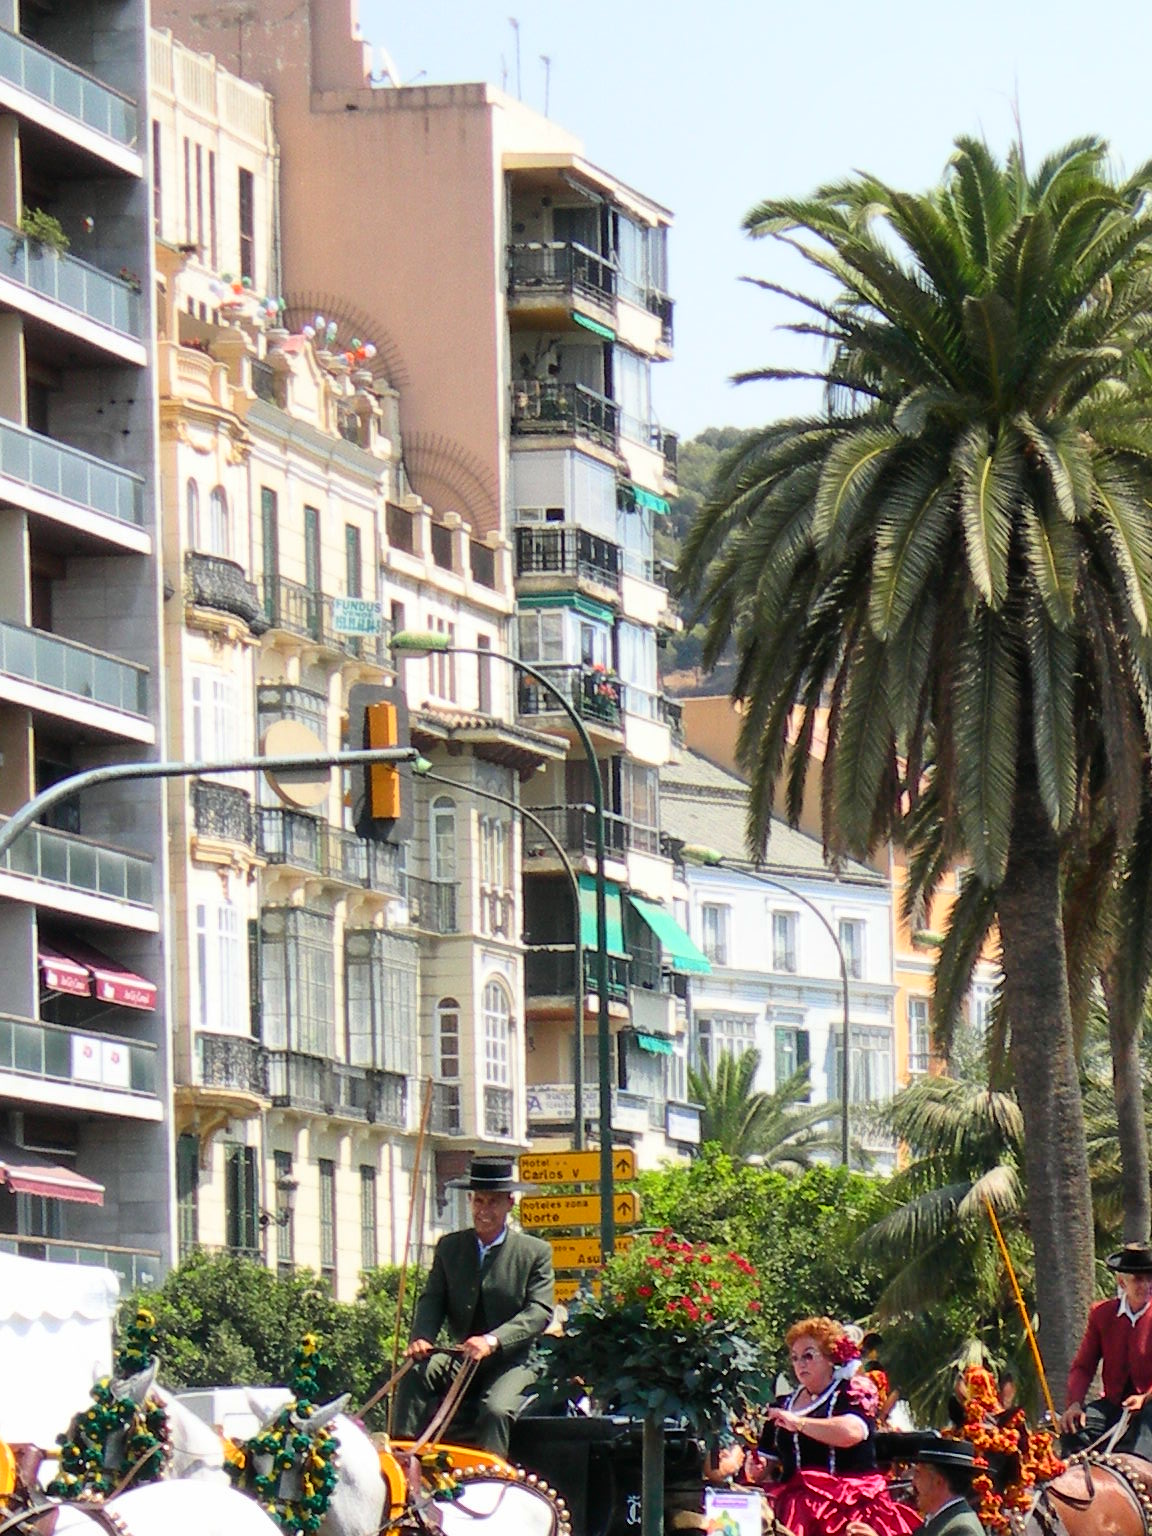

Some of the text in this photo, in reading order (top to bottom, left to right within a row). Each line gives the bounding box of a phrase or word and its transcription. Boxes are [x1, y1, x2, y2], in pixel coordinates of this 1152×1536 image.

[335, 600, 381, 613] FUNDUS
[522, 1159, 550, 1168] Hotel
[522, 1168, 579, 1180] Carlos V
[522, 1200, 588, 1210] hoteles zona
[523, 1213, 560, 1223] Norte
[577, 1254, 600, 1264] Asu
